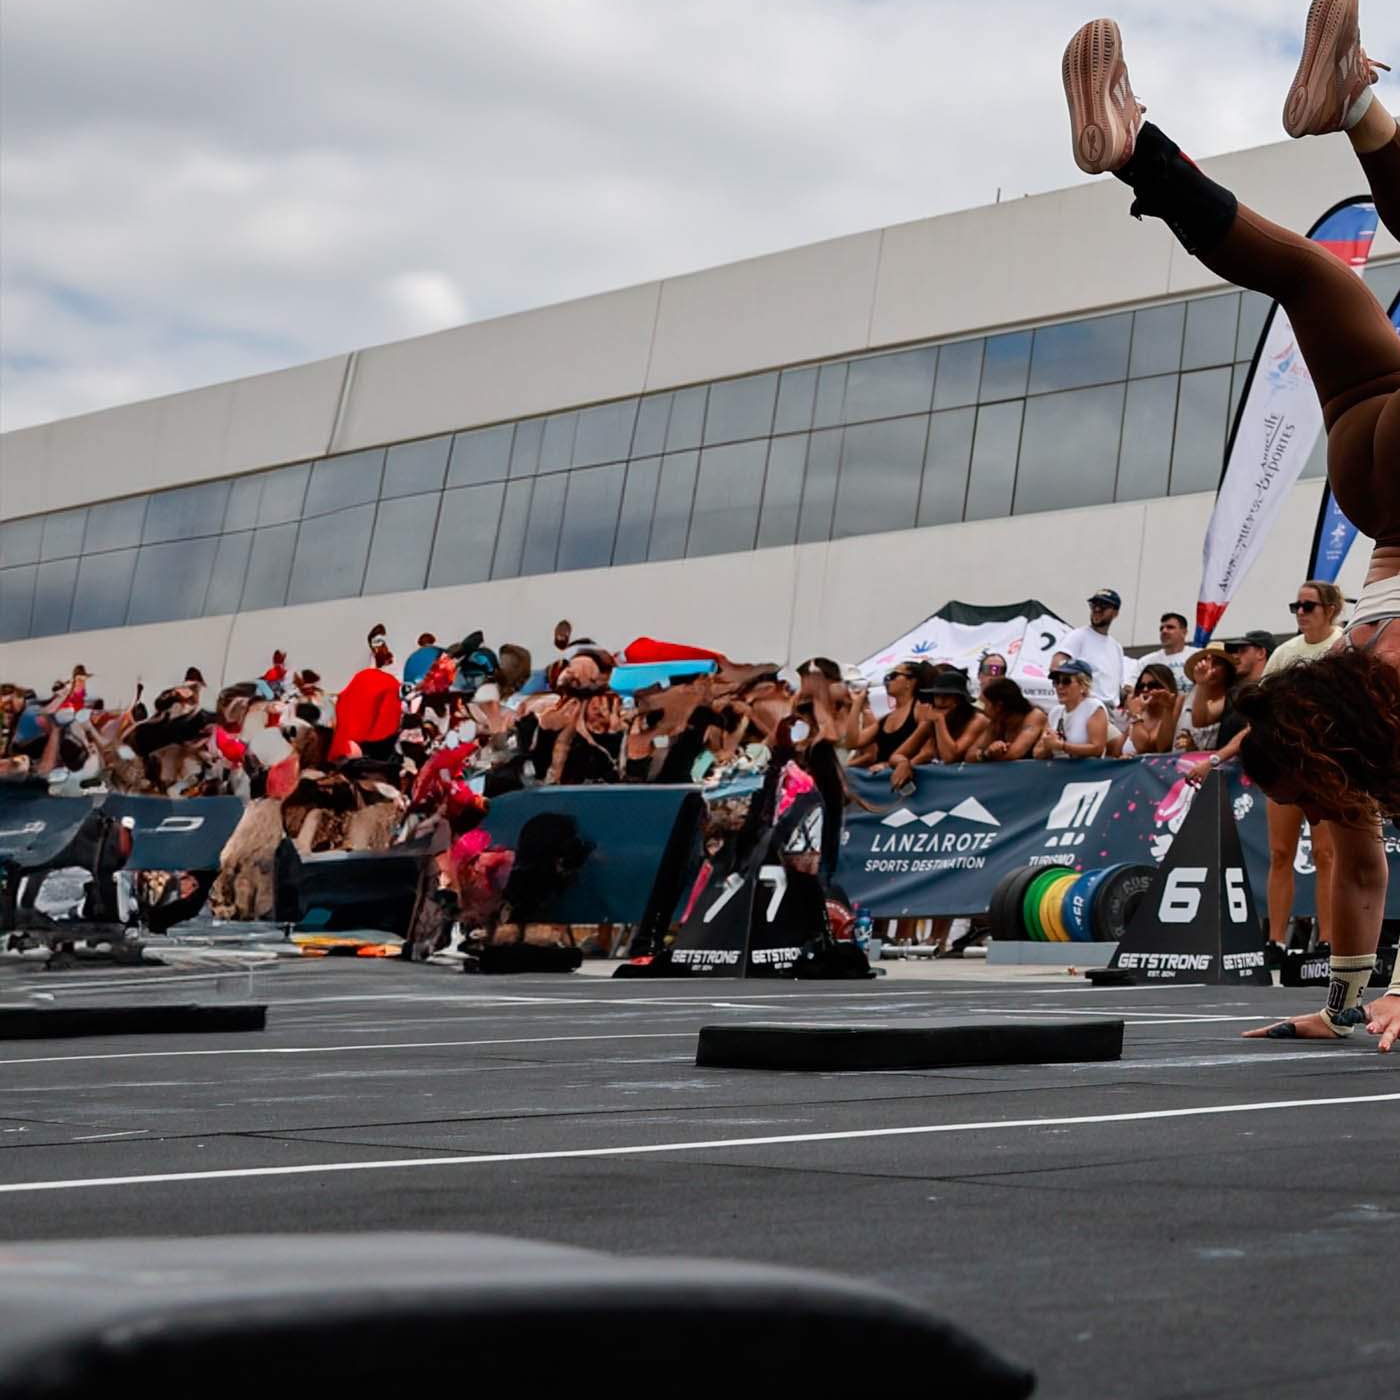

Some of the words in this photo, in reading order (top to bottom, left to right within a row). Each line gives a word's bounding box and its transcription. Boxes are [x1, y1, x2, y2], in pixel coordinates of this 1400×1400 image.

[869, 832, 997, 853] LANZAROTE
[864, 858, 909, 872] SPORTS
[911, 856, 986, 873] DESTINATION
[758, 865, 787, 923] 7
[1158, 867, 1208, 923] 6
[1225, 867, 1248, 923] 6
[671, 950, 741, 964] GETSTRONG
[751, 947, 801, 964] GETSTRO
[1118, 953, 1210, 970] GETSTRONG
[1222, 952, 1264, 971] GETSTRONG
